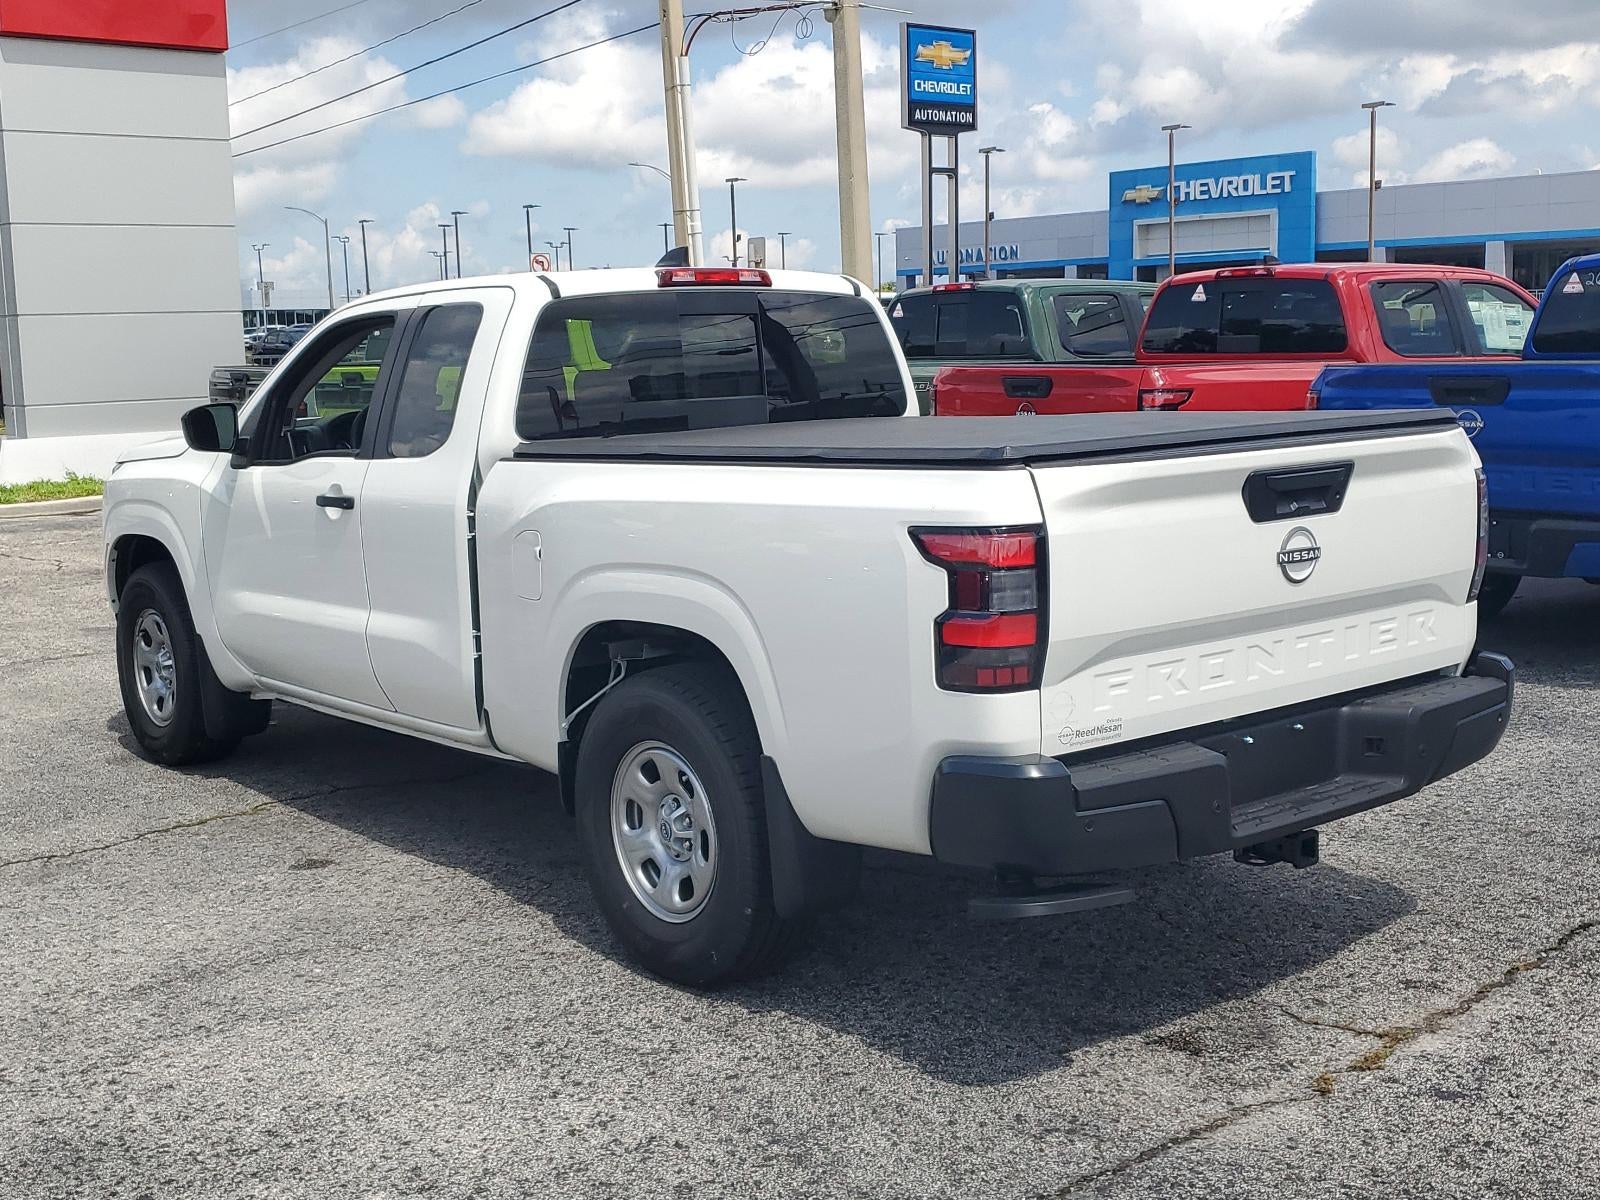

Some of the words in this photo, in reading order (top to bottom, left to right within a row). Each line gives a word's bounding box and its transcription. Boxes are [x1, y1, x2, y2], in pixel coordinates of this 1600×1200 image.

[914, 79, 972, 96] CHEVROLET
[914, 108, 973, 123] AUTONATION
[1166, 170, 1297, 202] CHEVROLET
[1456, 420, 1485, 428] SSAN
[1278, 547, 1321, 563] NISSAN
[1092, 607, 1438, 712] FRONTIER
[1074, 726, 1096, 739] Reed
[1096, 723, 1123, 736] Nissan
